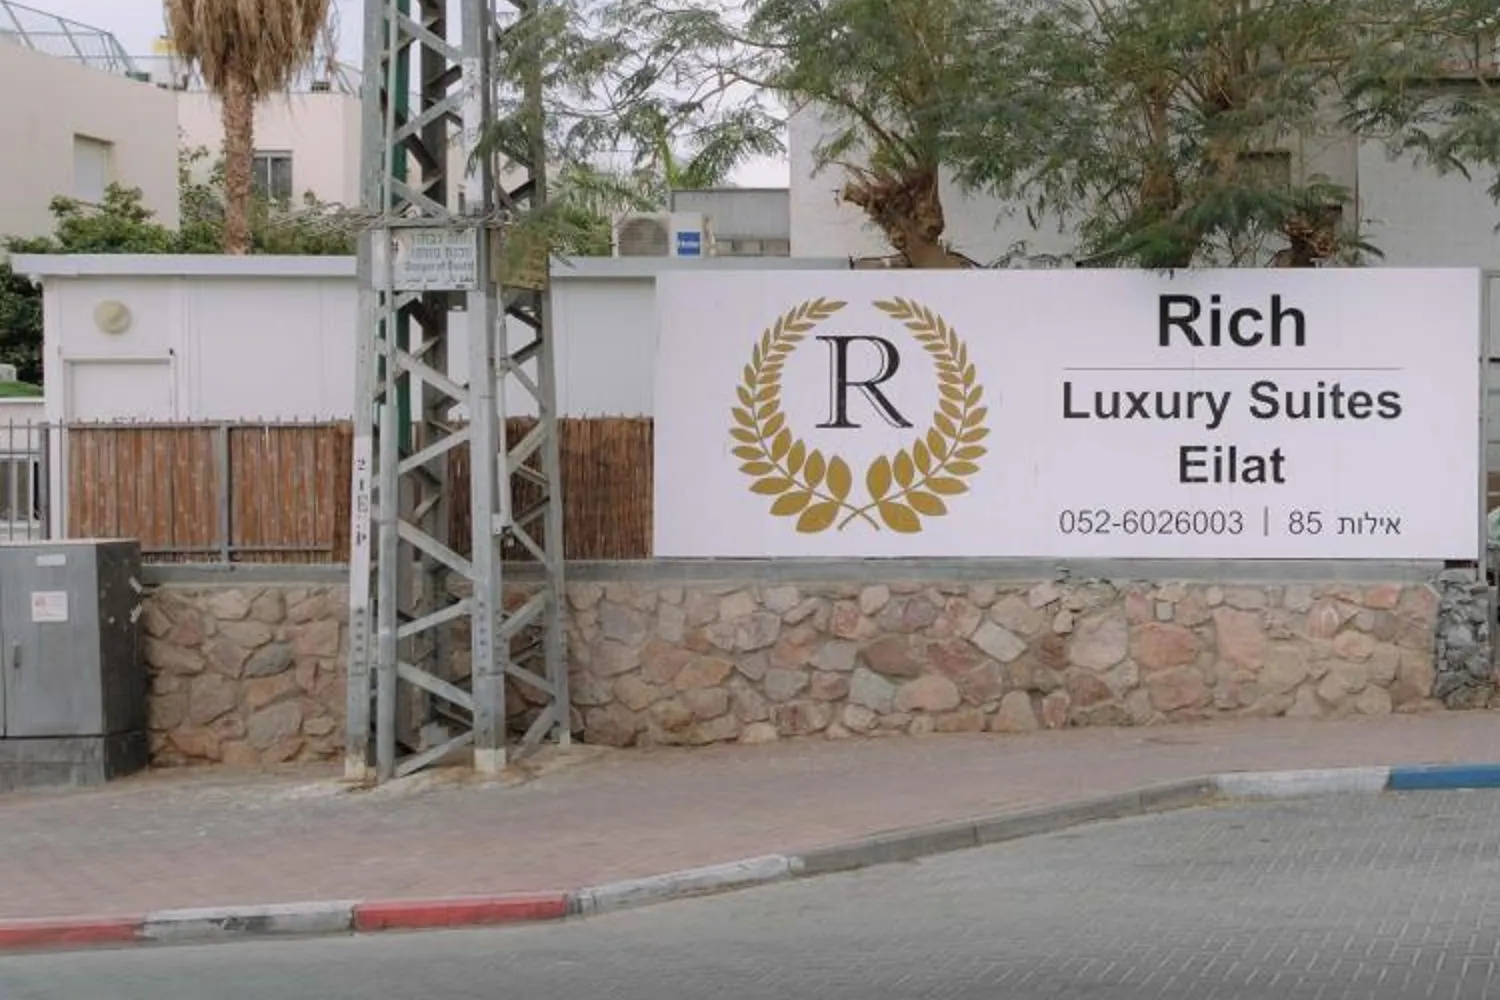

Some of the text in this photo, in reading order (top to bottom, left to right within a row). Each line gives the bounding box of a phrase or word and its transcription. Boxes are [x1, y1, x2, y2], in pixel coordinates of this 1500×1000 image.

[1159, 293, 1306, 348] Rich
[815, 335, 914, 428] R
[1063, 380, 1403, 430] Luxury Suites
[1179, 445, 1286, 484] Eilat
[1059, 509, 1244, 536] 052-6026003
[1288, 510, 1402, 536] אילות 85
